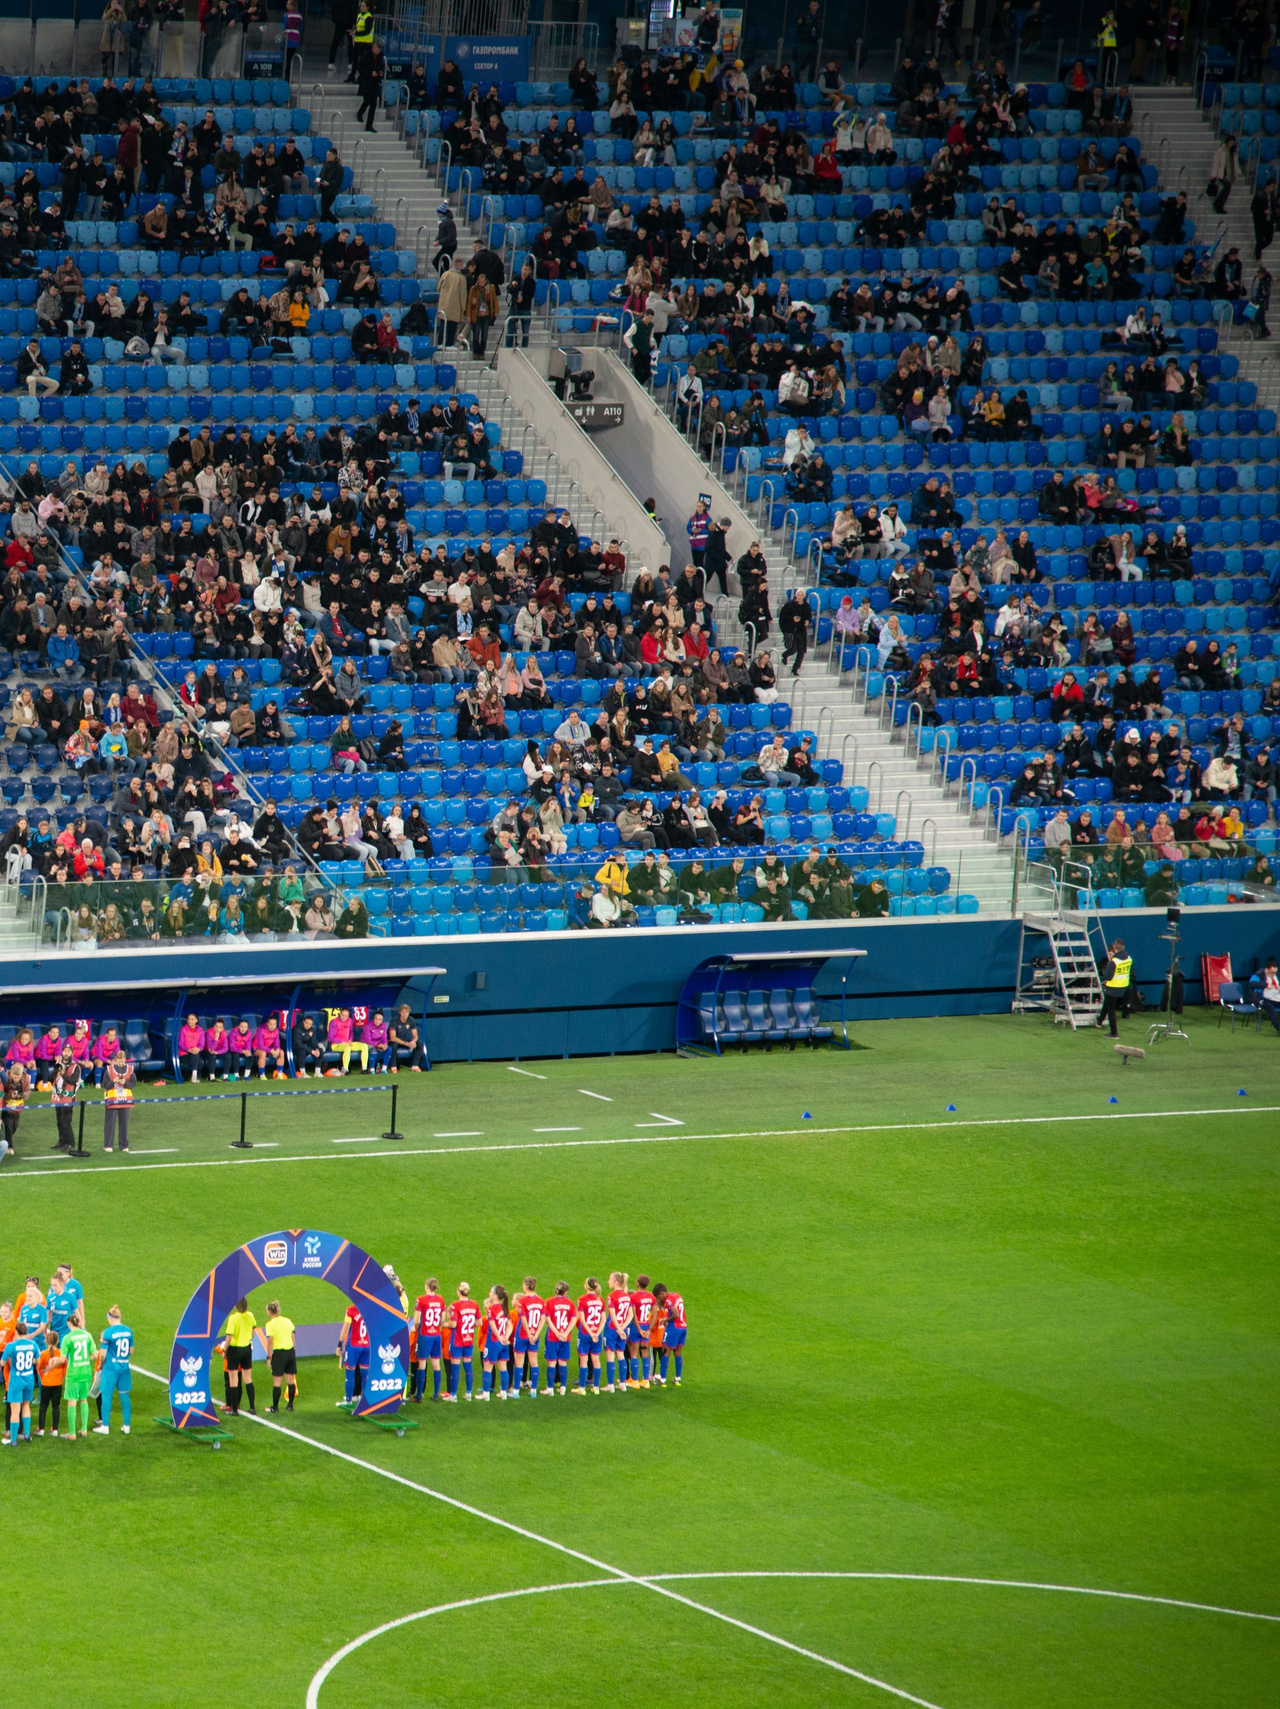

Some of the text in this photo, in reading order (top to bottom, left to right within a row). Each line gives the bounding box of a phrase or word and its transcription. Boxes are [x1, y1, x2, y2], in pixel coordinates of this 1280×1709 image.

[472, 45, 519, 55] ГАЗПРОМБАНК
[260, 63, 273, 71] 109
[474, 62, 492, 70] СЕКТОР
[603, 407, 622, 416] A110
[425, 1307, 442, 1327] 93
[528, 1309, 541, 1328] 10
[554, 1310, 568, 1330] 14
[586, 1306, 602, 1325] 25
[616, 1302, 630, 1321] 27
[461, 1314, 476, 1335] 22
[73, 1339, 88, 1360] 21
[115, 1338, 130, 1358] 19
[16, 1350, 34, 1372] 88
[370, 1378, 403, 1391] 2022
[174, 1391, 206, 1405] 2022
